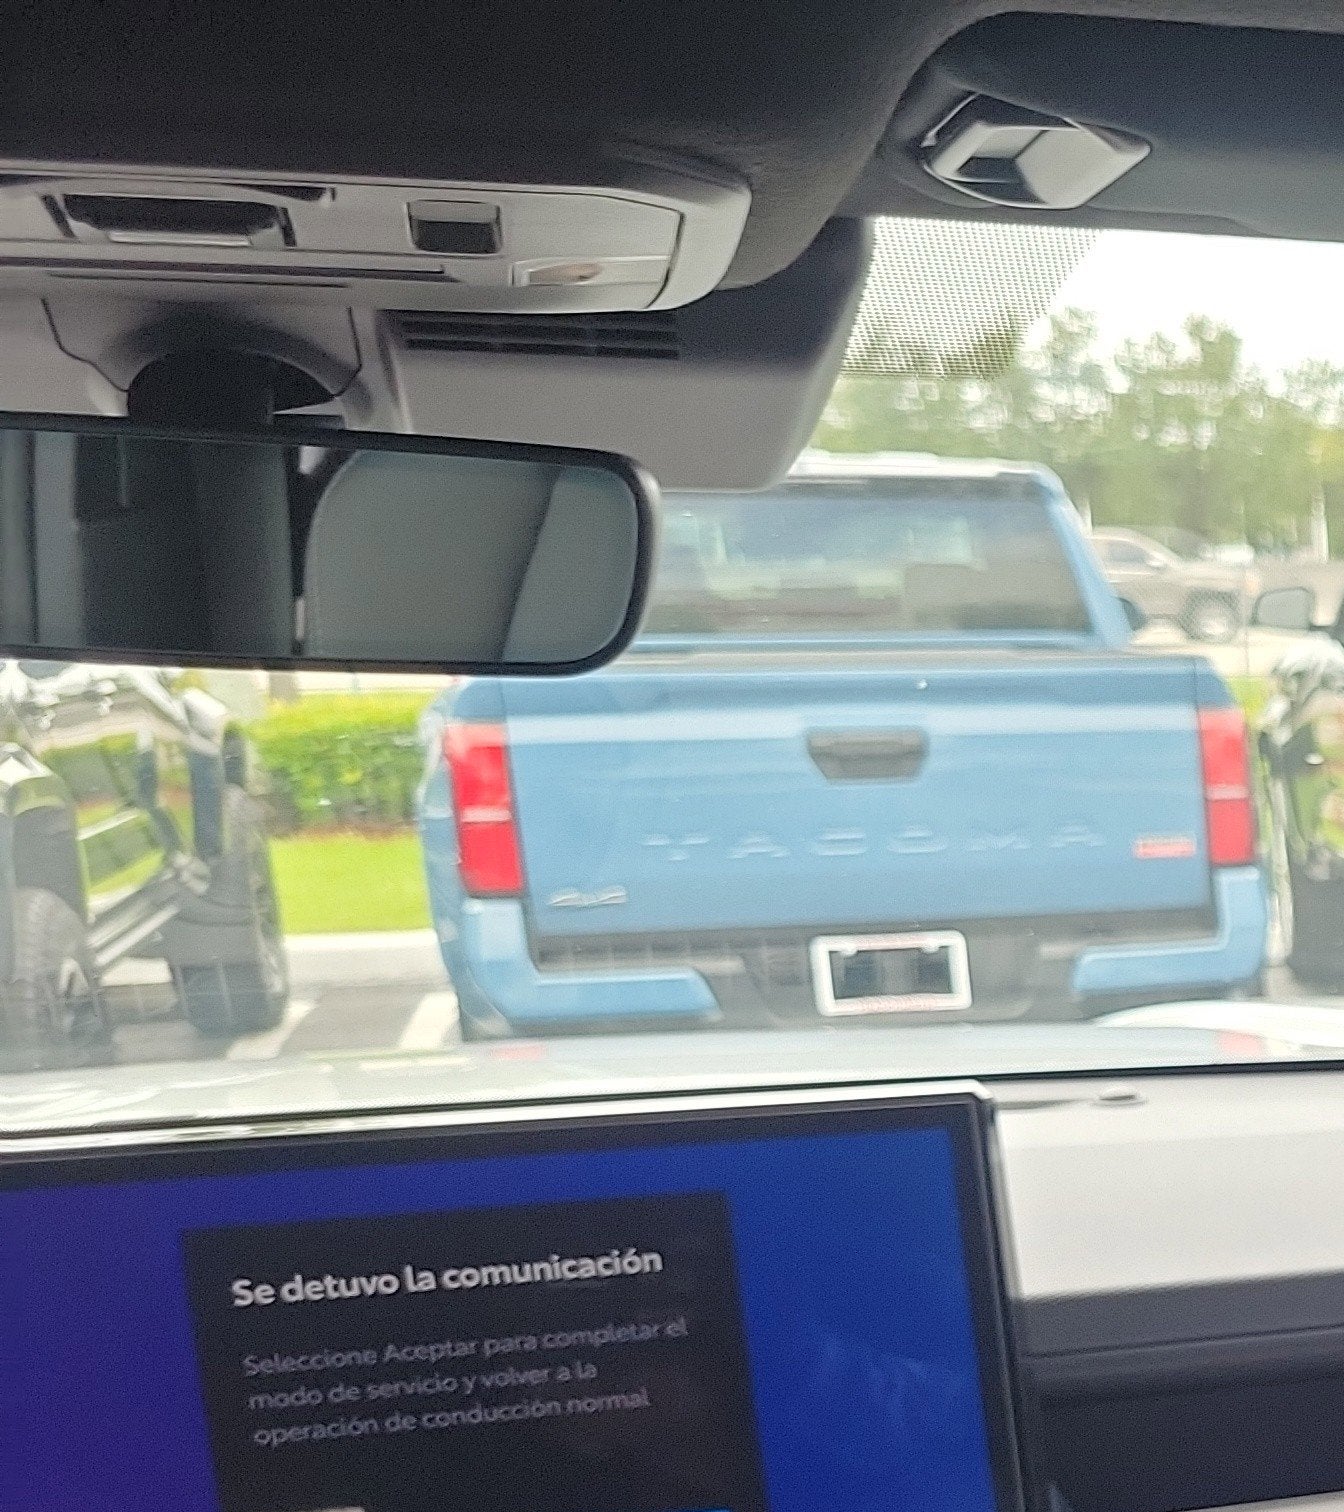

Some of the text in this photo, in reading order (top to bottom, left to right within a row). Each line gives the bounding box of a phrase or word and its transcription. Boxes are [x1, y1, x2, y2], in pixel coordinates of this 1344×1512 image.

[231, 1248, 664, 1307] Se detuvo la comunicación
[243, 1317, 688, 1377] Seleccione Aceptar para completar el
[249, 1359, 598, 1410] modo de servicio y volver a la
[253, 1385, 651, 1450] operación de conducción normal
